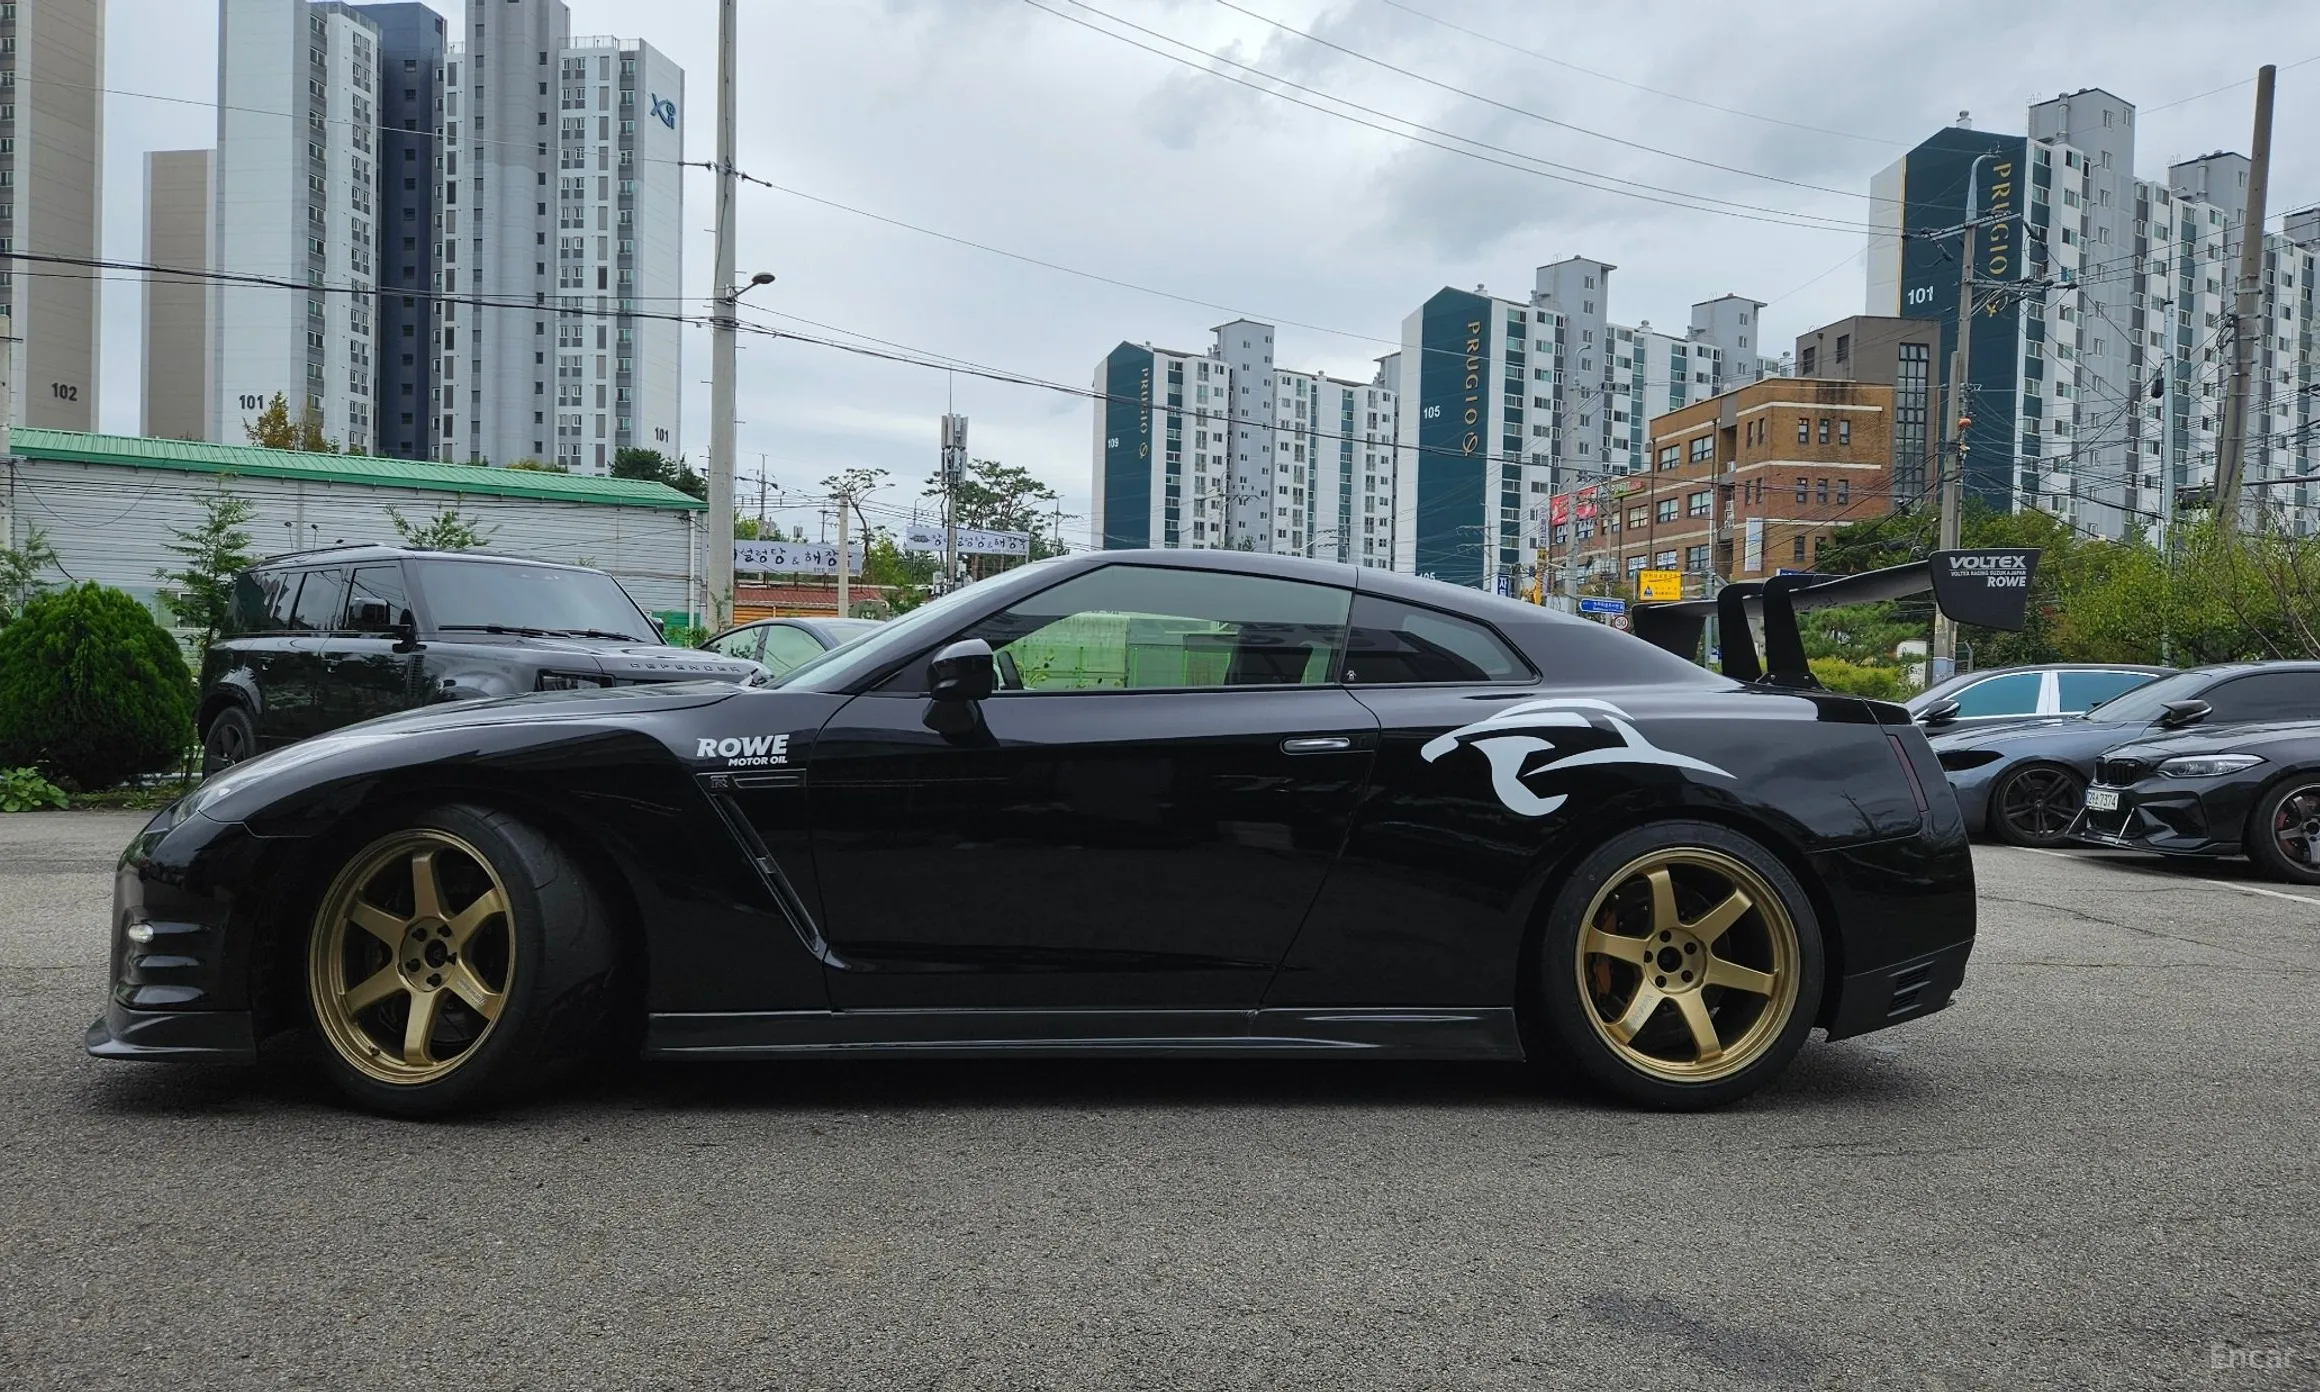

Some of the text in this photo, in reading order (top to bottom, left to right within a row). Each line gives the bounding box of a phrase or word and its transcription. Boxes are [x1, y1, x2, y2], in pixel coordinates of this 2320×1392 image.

[1907, 285, 1934, 305] 101
[1464, 321, 1481, 425] PRUGIO
[51, 382, 78, 401] 102
[239, 394, 264, 410] 101
[1423, 405, 1441, 419] 105
[655, 426, 669, 443] 101
[1949, 555, 2026, 569] VOLTEX
[1987, 576, 2027, 588] ROWE
[1616, 618, 1627, 627] 30
[630, 663, 741, 673] DEFENDER
[696, 734, 790, 757] ROWE
[728, 755, 788, 767] MOTOR OIL
